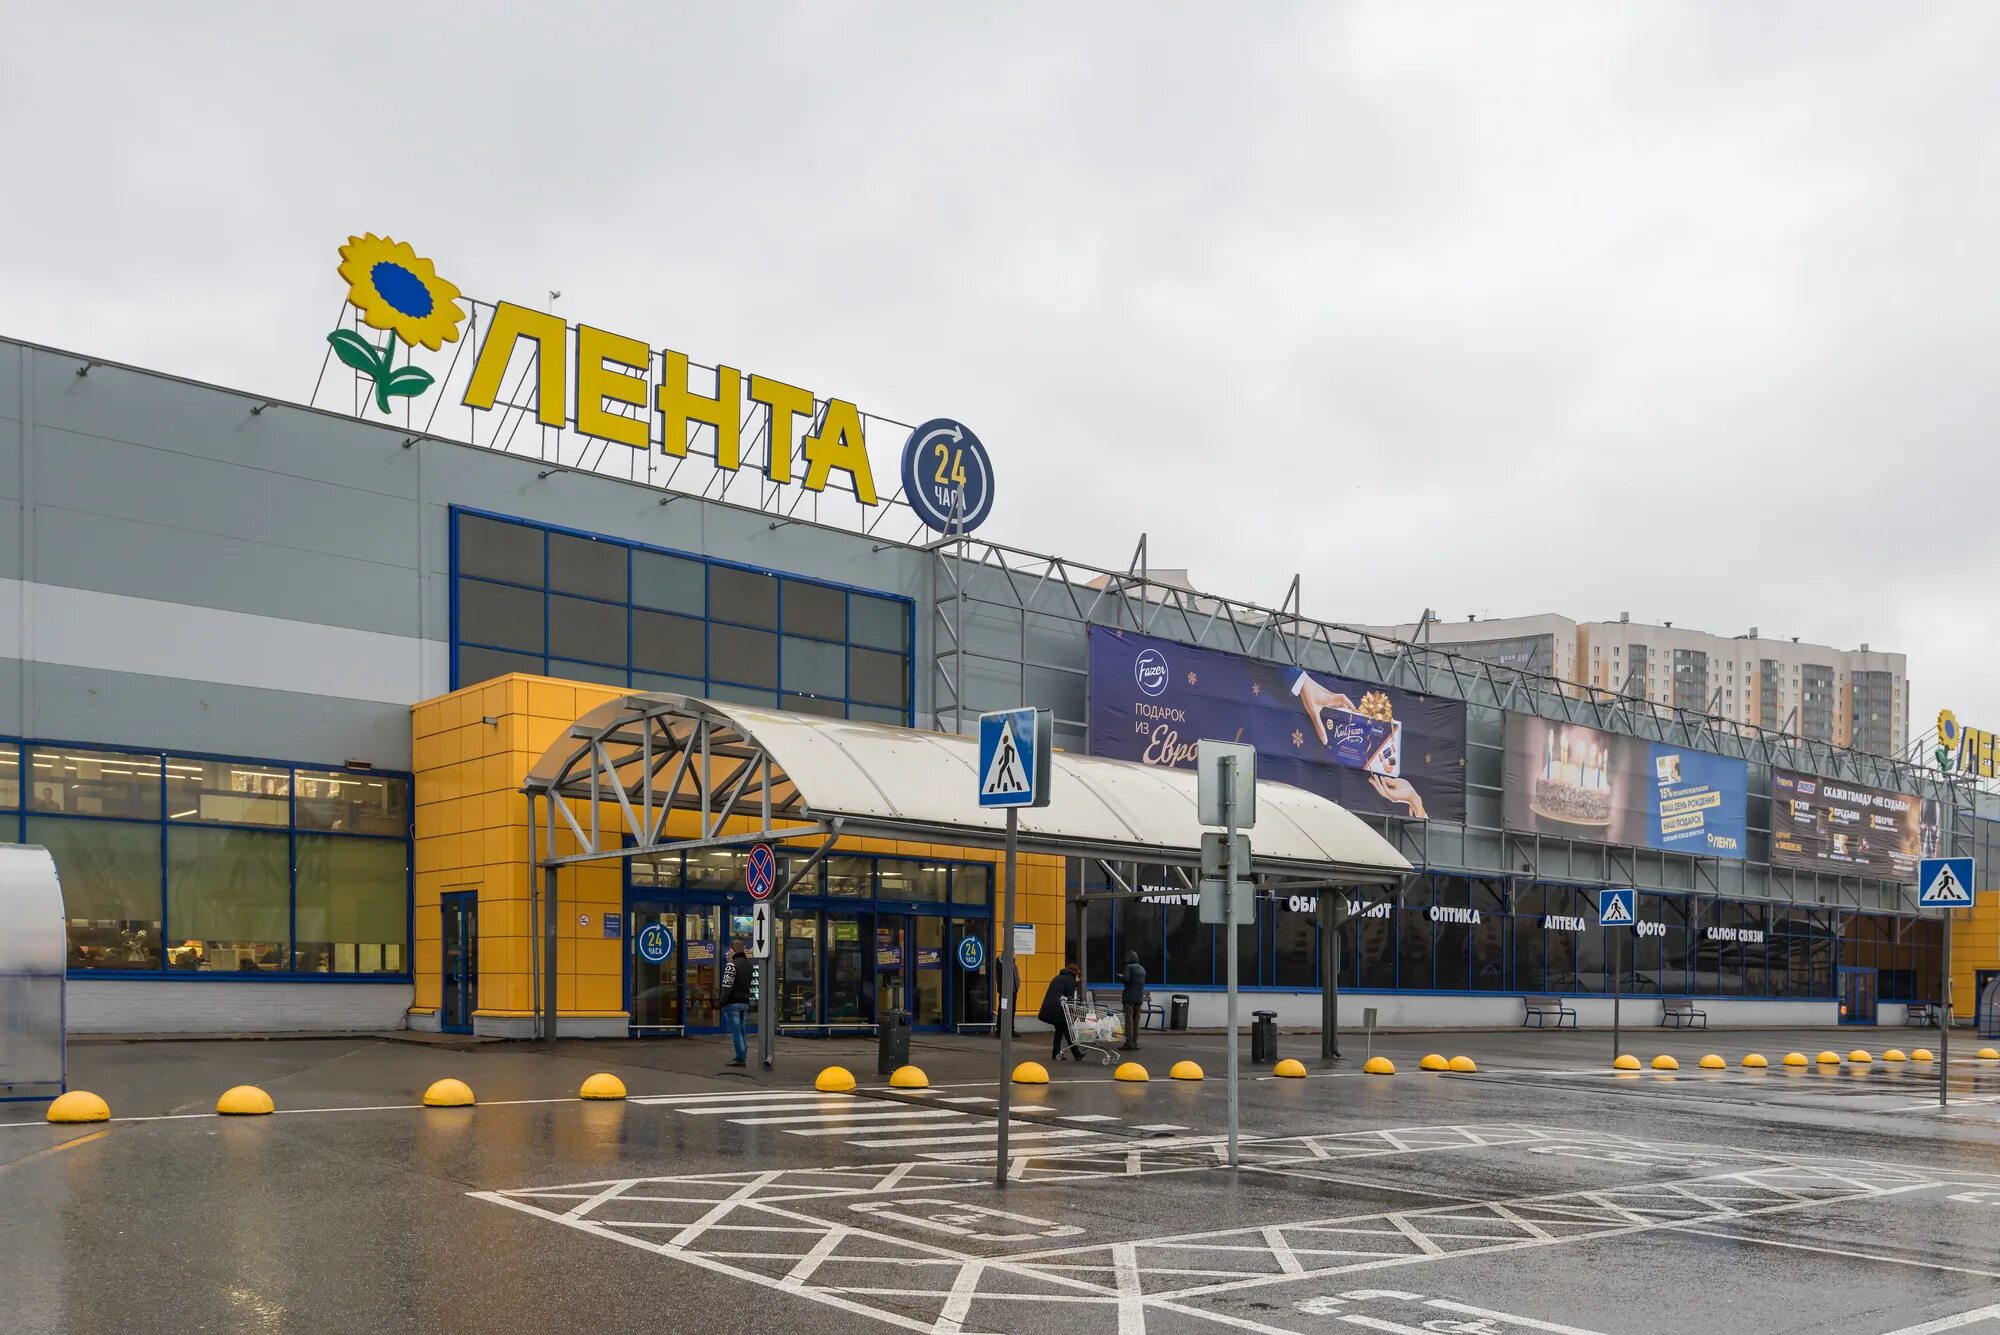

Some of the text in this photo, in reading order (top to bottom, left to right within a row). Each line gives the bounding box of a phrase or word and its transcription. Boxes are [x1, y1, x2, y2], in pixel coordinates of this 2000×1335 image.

[461, 300, 878, 506] ЛЕНТА
[934, 443, 967, 488] 24
[1139, 658, 1167, 682] Fazer
[1135, 702, 1186, 723] ПОДАРОК
[1135, 720, 1200, 768] ИЗ Евро
[1660, 787, 1673, 799] 15%
[1824, 786, 1847, 801] СКАЖИ
[1848, 790, 1872, 806] ГОЛОДУ
[1662, 804, 1674, 814] ВАШ
[1674, 801, 1687, 812] ДЕНЬ
[1790, 799, 1795, 816] 1
[1828, 806, 1834, 822] 2
[1663, 815, 1702, 830] НАШ ПОДАРОК
[1713, 836, 1737, 850] ЛЕНТА
[1429, 906, 1481, 924] ОПТИКА
[1544, 915, 1586, 932] АПТЕКА
[1636, 920, 1666, 937] ФОТО
[1707, 926, 1764, 943] САЛОН СВЯЗИ
[648, 931, 663, 947] 24
[648, 947, 663, 955] ЧАСА
[965, 943, 976, 957] 24
